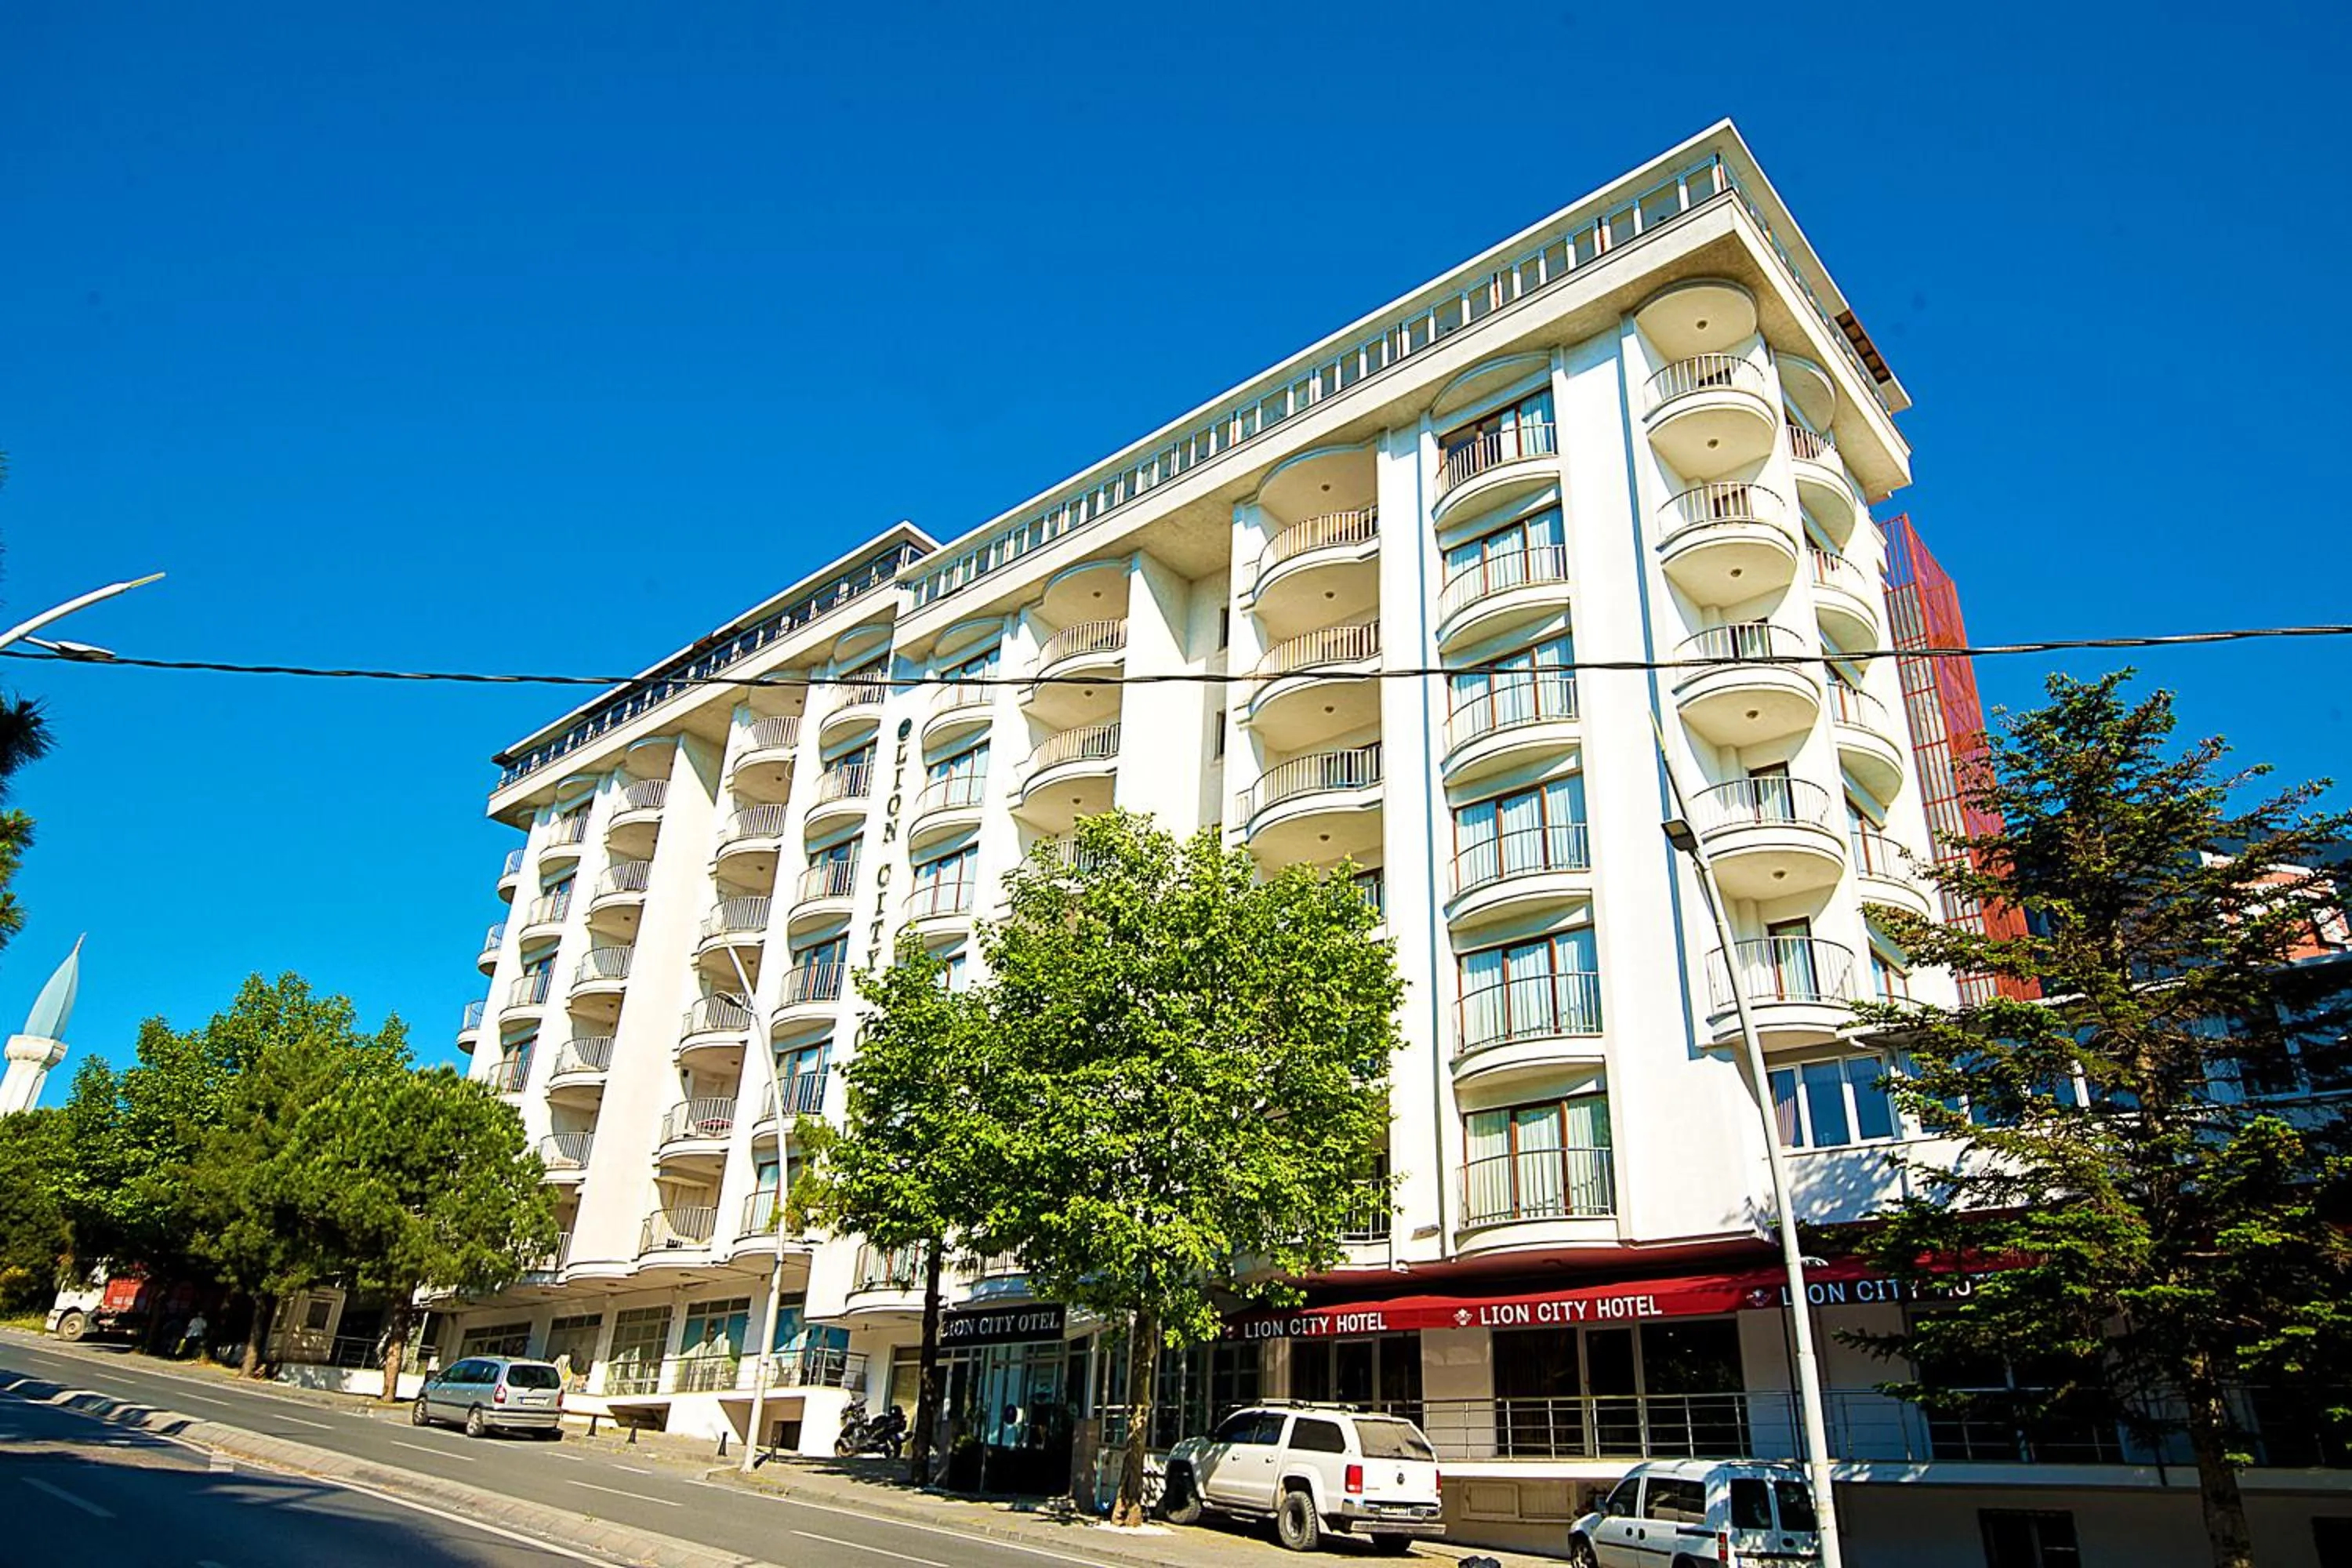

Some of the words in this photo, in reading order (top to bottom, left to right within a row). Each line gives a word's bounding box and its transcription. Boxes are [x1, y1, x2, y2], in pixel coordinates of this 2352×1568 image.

[883, 742, 908, 845] LION
[867, 863, 891, 973] CITY
[1780, 1282, 1846, 1305] LON
[1479, 1304, 1530, 1325] LION
[1537, 1300, 1588, 1322] CITY
[1596, 1294, 1663, 1319] HOTEL
[940, 1318, 975, 1338] LION
[979, 1315, 1015, 1334] CITY
[1018, 1312, 1060, 1332] OTEL
[1244, 1320, 1283, 1339] LION
[1290, 1316, 1330, 1336] CITY
[1336, 1312, 1387, 1333] HOTEL
